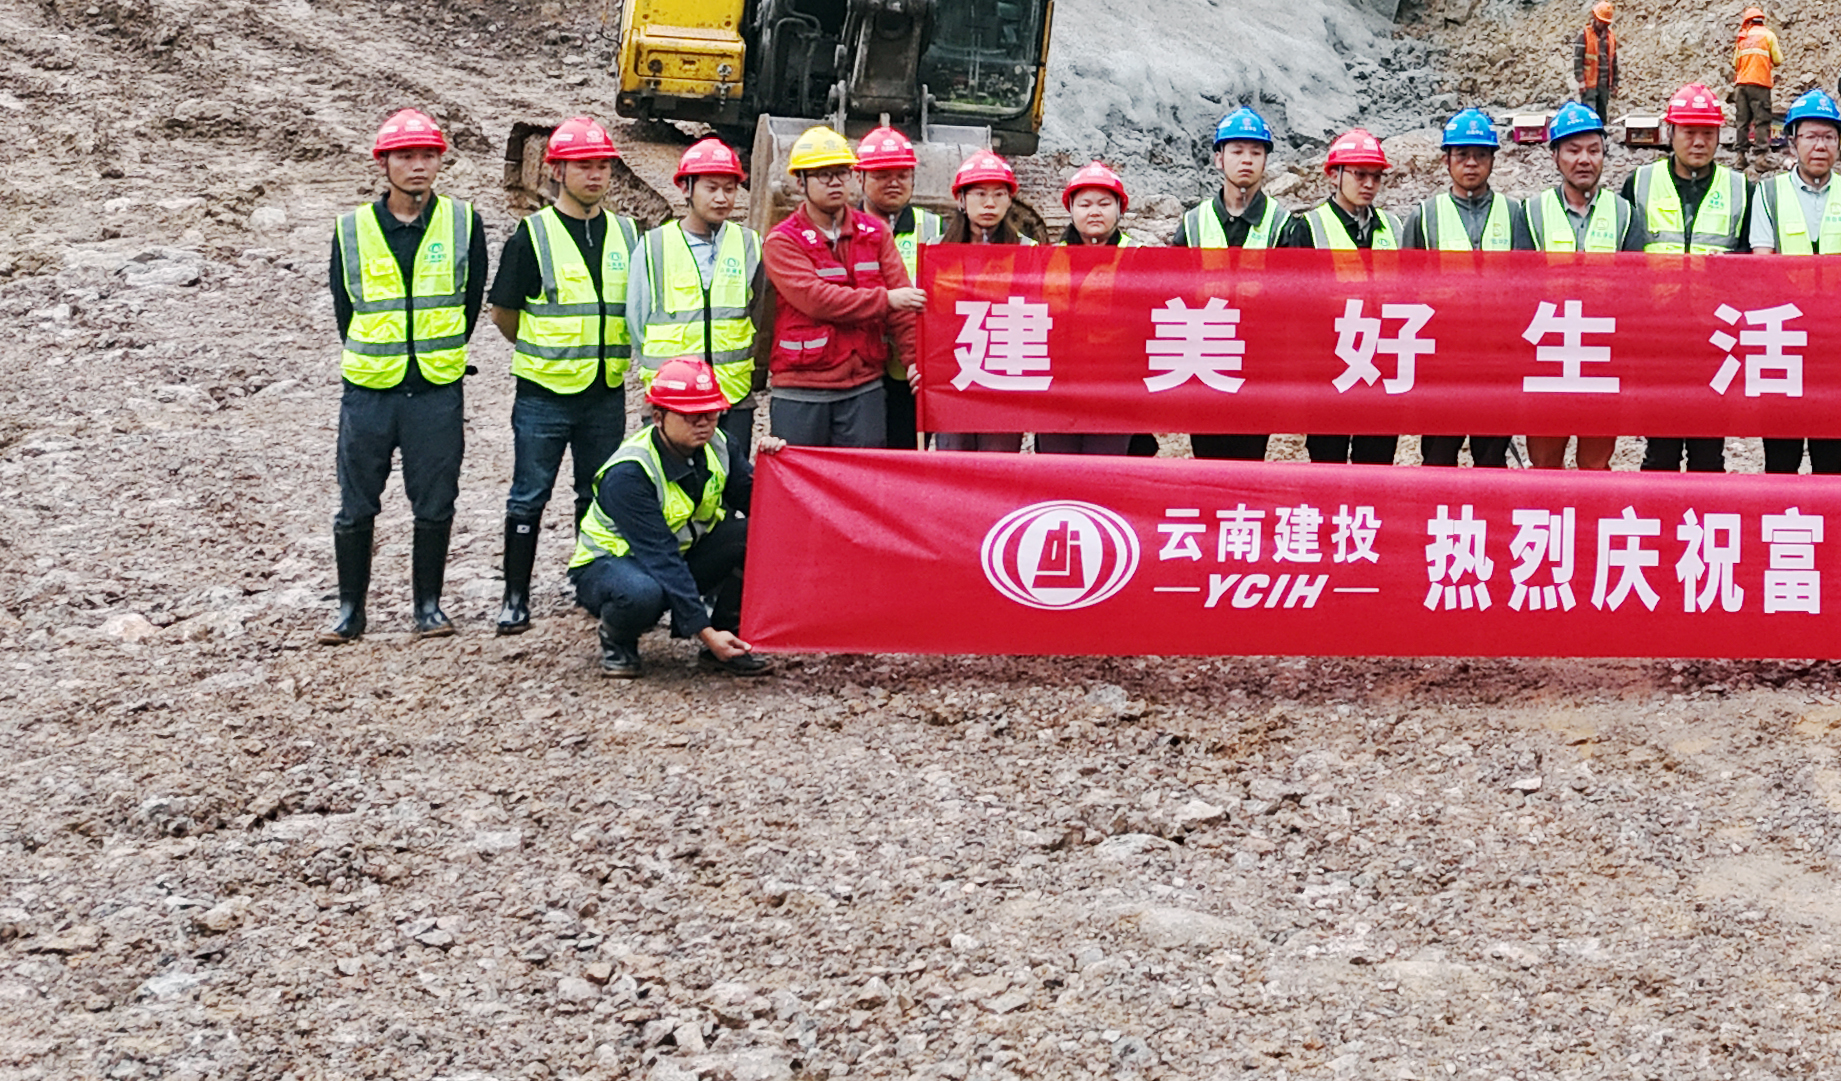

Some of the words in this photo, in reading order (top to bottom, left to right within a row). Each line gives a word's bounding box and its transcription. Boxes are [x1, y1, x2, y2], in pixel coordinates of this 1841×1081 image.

[950, 296, 1808, 397] 建美好生活
[1157, 503, 1382, 564] 云南建投
[1204, 573, 1330, 608] YCIH
